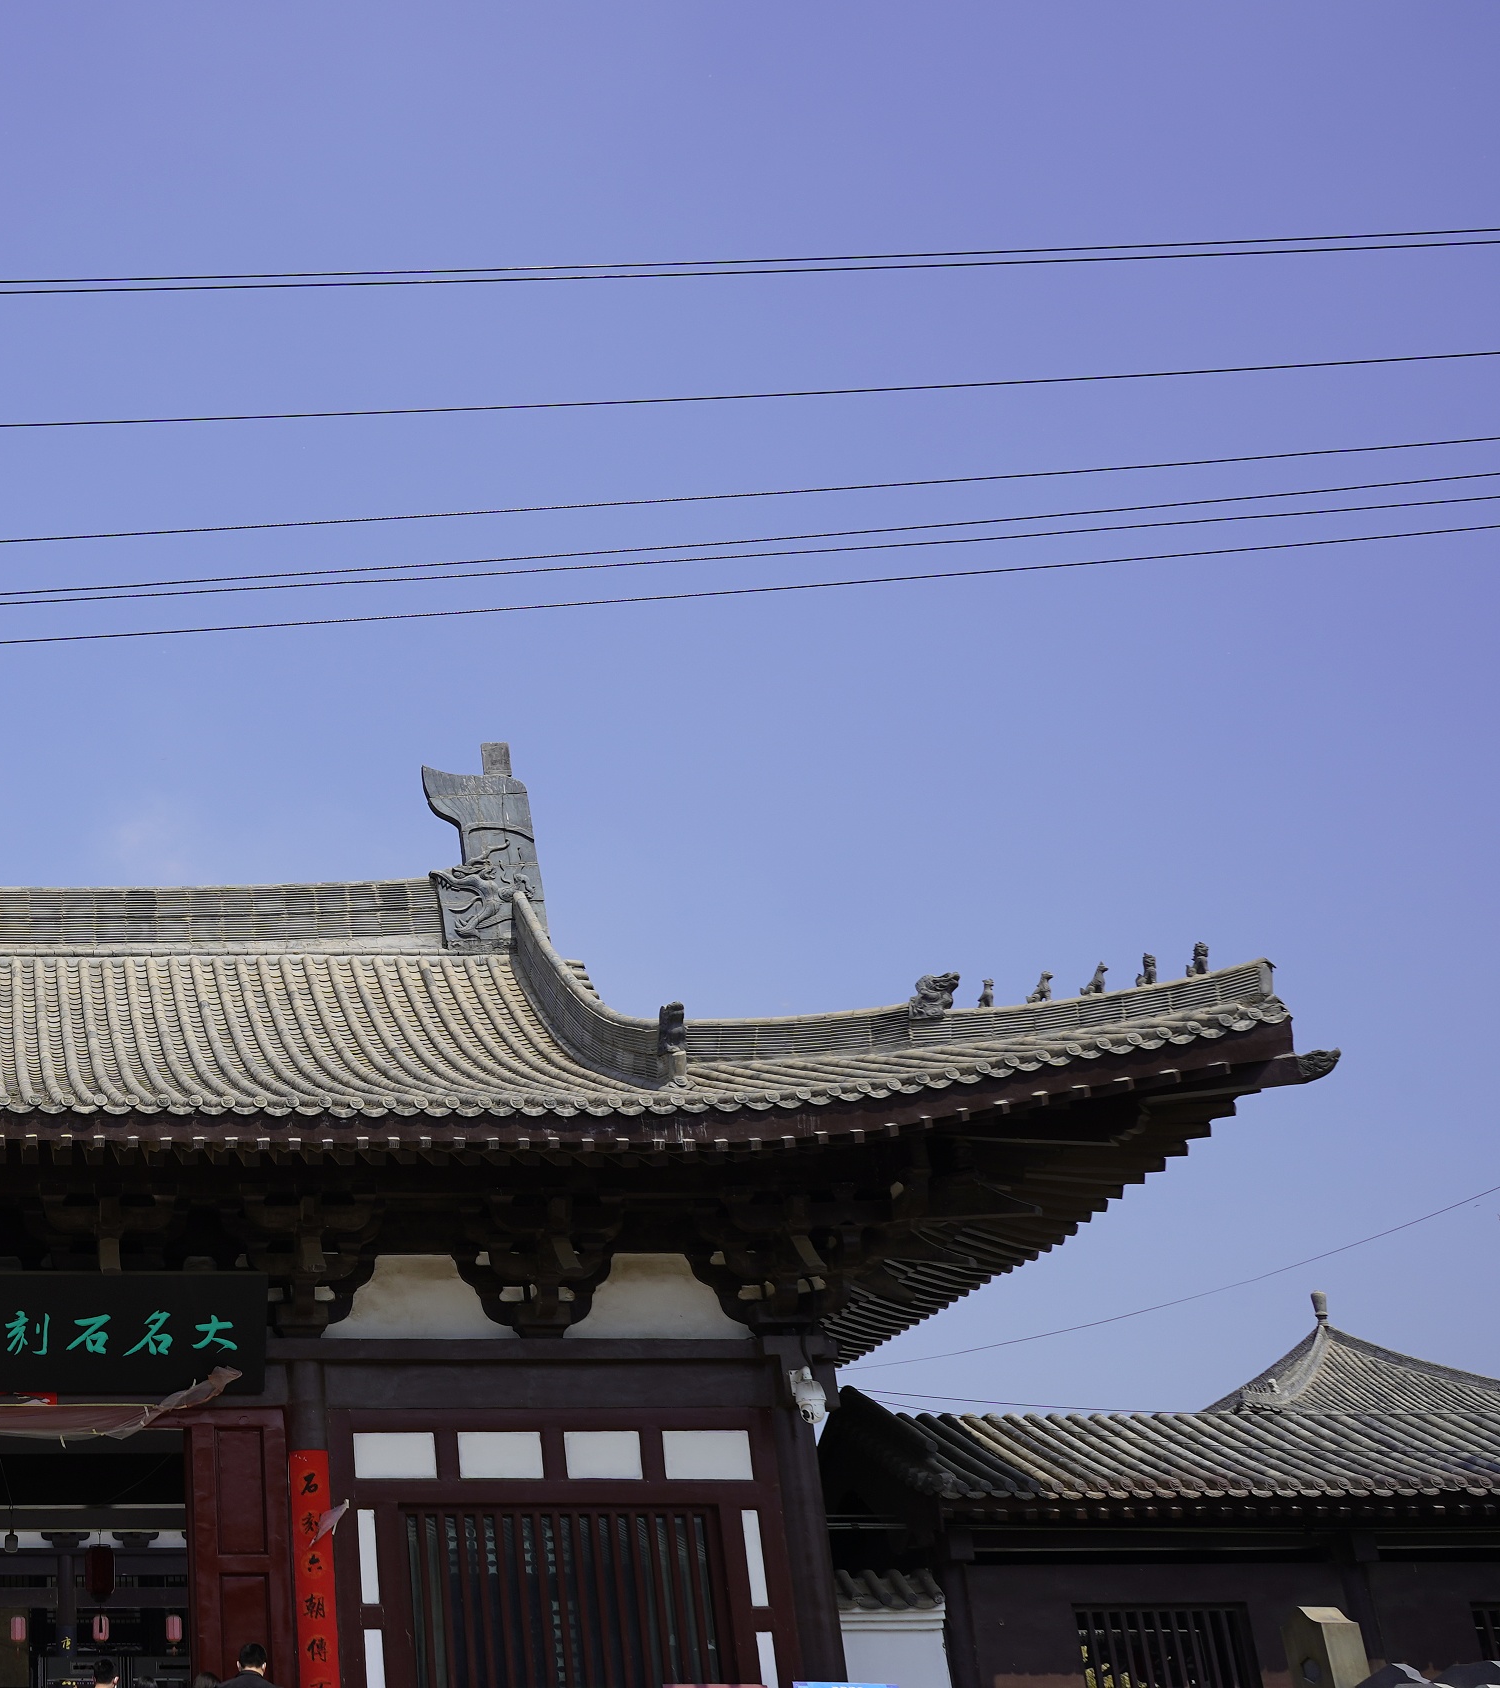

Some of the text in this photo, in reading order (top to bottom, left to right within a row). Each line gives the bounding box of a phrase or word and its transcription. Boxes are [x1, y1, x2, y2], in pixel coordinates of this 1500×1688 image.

[301, 1472, 332, 1688] 石刻六朝傳
